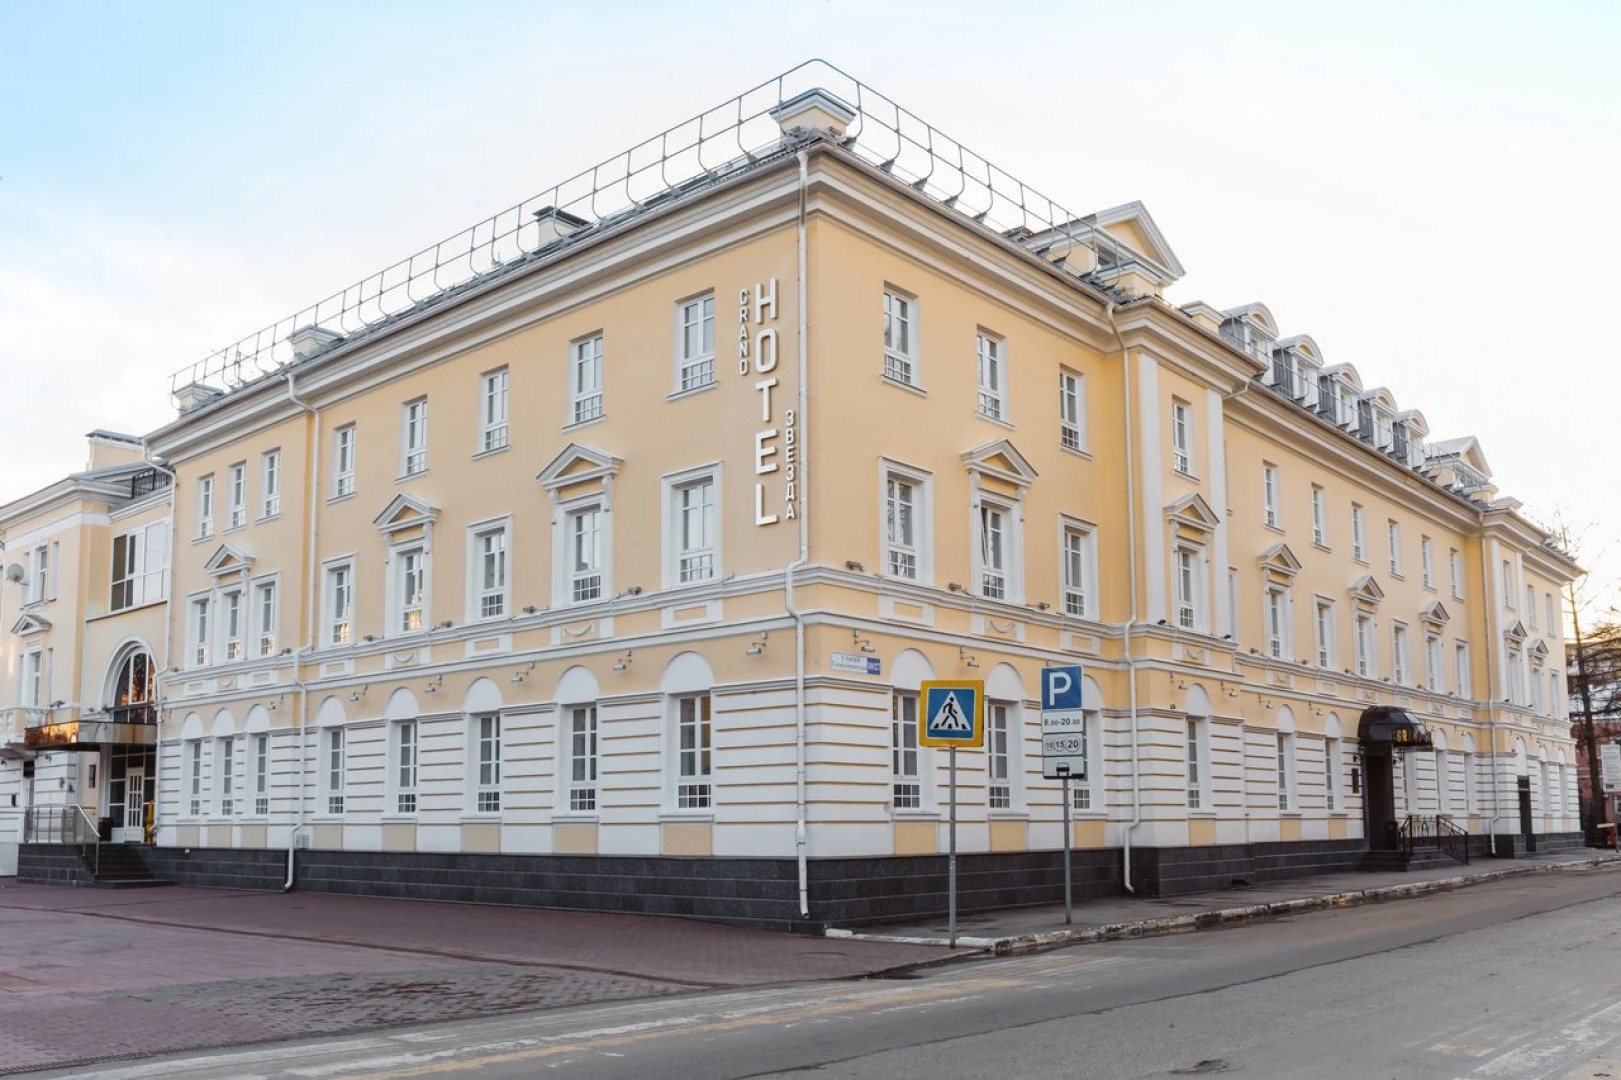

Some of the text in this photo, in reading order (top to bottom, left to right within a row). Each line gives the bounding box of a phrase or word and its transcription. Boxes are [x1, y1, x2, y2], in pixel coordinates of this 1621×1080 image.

[739, 289, 749, 376] GRAND
[755, 277, 779, 526] HOTEL
[785, 409, 796, 520] ЗВЕЗДА
[1049, 671, 1072, 706] P
[1056, 740, 1065, 748] 15
[1067, 740, 1079, 748] 20
